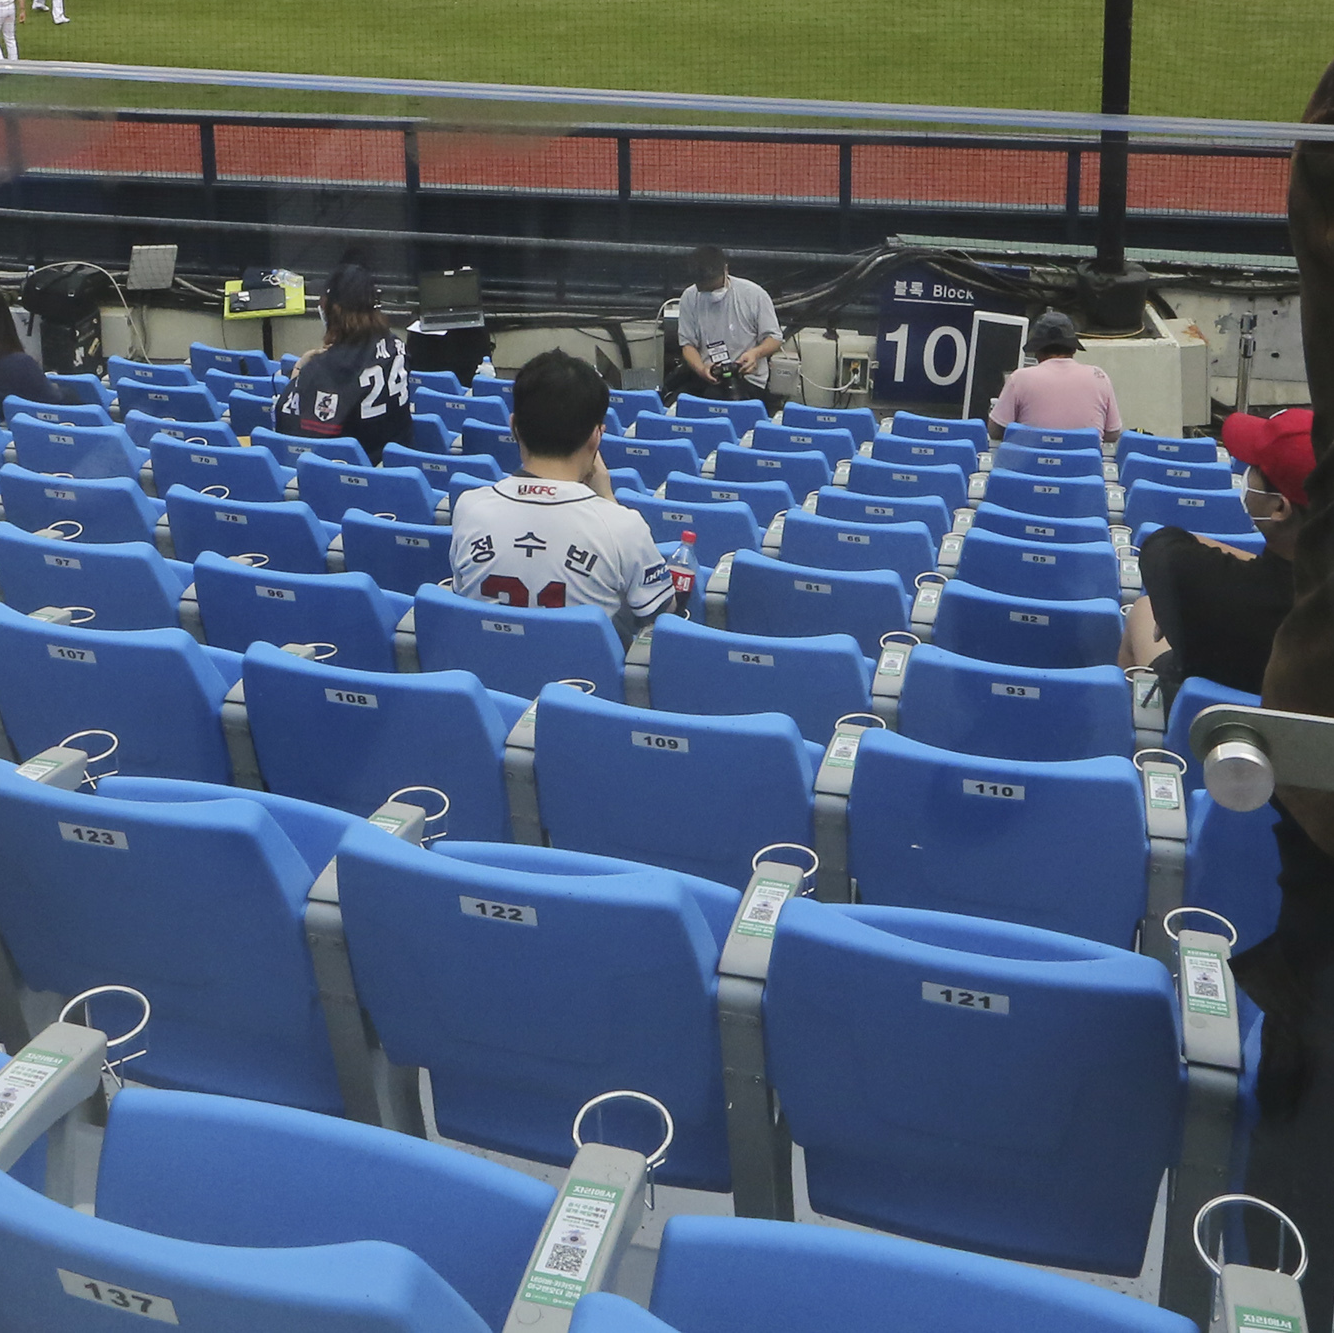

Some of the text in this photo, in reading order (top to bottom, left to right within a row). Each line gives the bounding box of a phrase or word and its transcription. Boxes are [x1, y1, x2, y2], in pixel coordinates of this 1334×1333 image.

[893, 280, 976, 300] 블록 Block
[885, 323, 968, 387] 10
[359, 354, 411, 420] 24
[347, 476, 360, 484] 69
[528, 485, 558, 496] KFC
[225, 514, 239, 523] 78
[670, 513, 684, 521] 67
[406, 538, 420, 546] 79
[846, 535, 861, 543] 66
[470, 531, 599, 578] 정수빈
[1032, 555, 1047, 563] 65
[55, 556, 71, 566] 97
[267, 588, 285, 599] 96
[805, 583, 821, 592] 81
[1020, 615, 1038, 624] 82
[492, 622, 512, 633] 95
[57, 648, 86, 661] 107
[741, 654, 761, 664] 94
[1005, 686, 1026, 696] 93
[334, 691, 367, 706] 108
[644, 735, 679, 750] 109
[974, 782, 1013, 797] 110
[73, 827, 115, 845] 123
[475, 902, 524, 921] 122
[938, 988, 991, 1010] 121
[572, 1184, 618, 1199] 자리에서
[83, 1281, 155, 1315] 137
[1243, 1313, 1293, 1330] 자리에서
